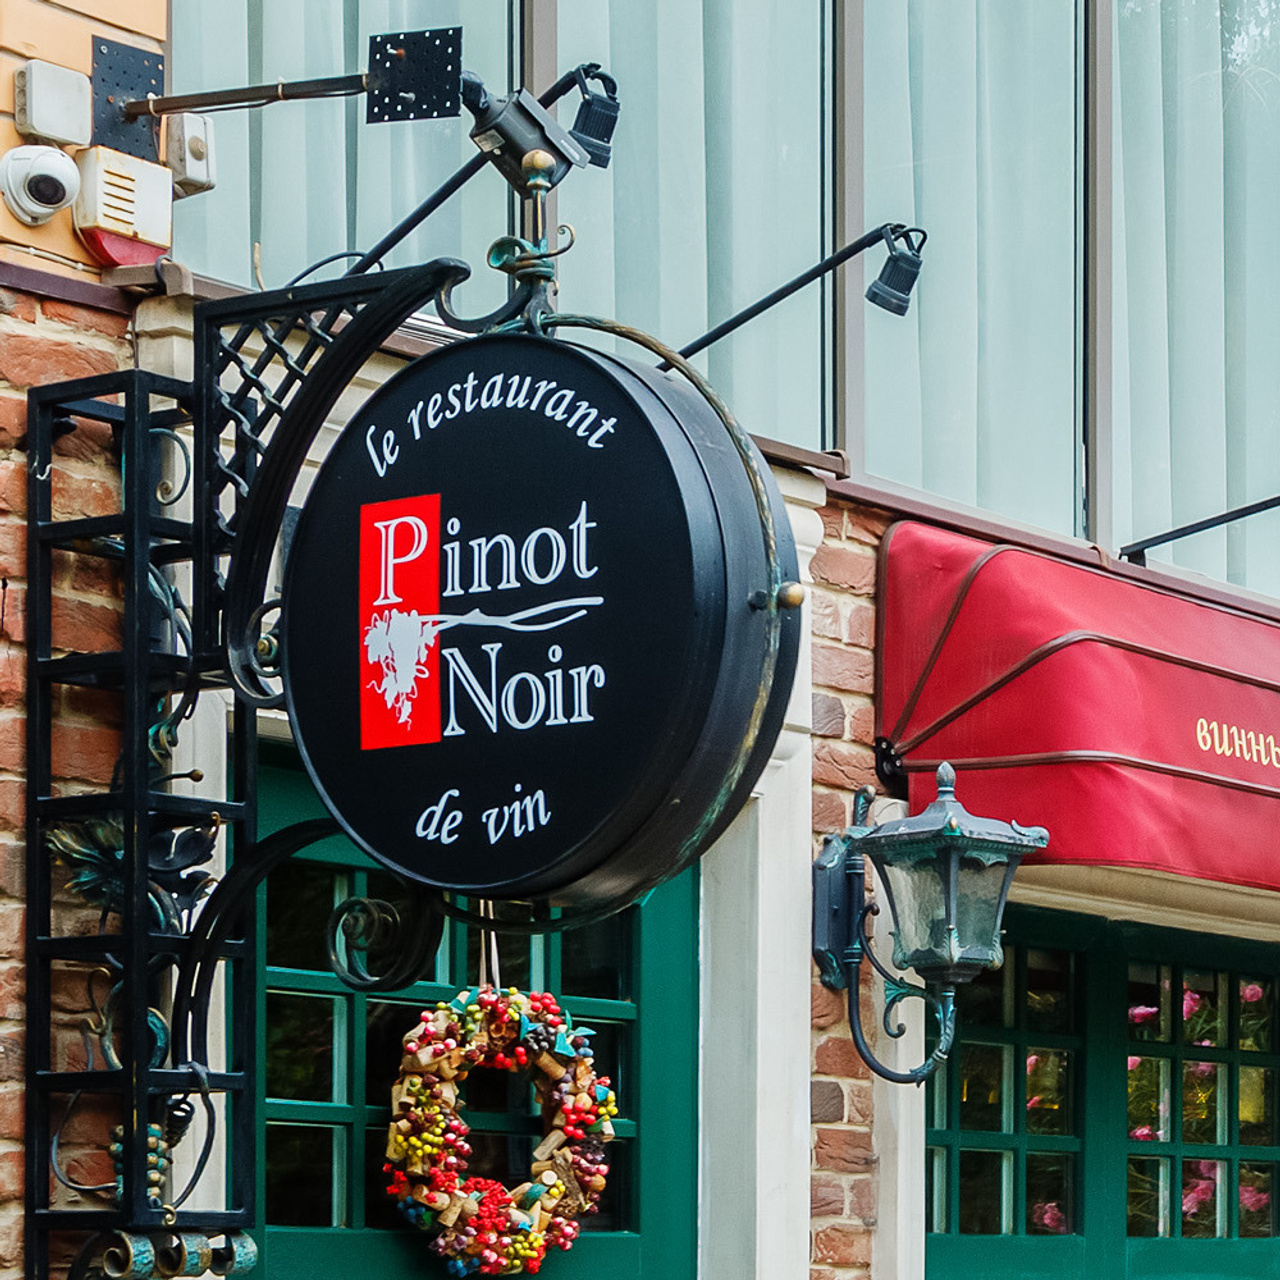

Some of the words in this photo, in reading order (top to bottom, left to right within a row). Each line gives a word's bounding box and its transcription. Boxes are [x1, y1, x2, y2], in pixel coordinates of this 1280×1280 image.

[365, 424, 400, 478] le
[407, 370, 618, 449] restaurant
[372, 500, 599, 606] Pinot
[442, 641, 606, 737] Noir
[415, 788, 461, 846] de
[481, 782, 552, 846] vin
